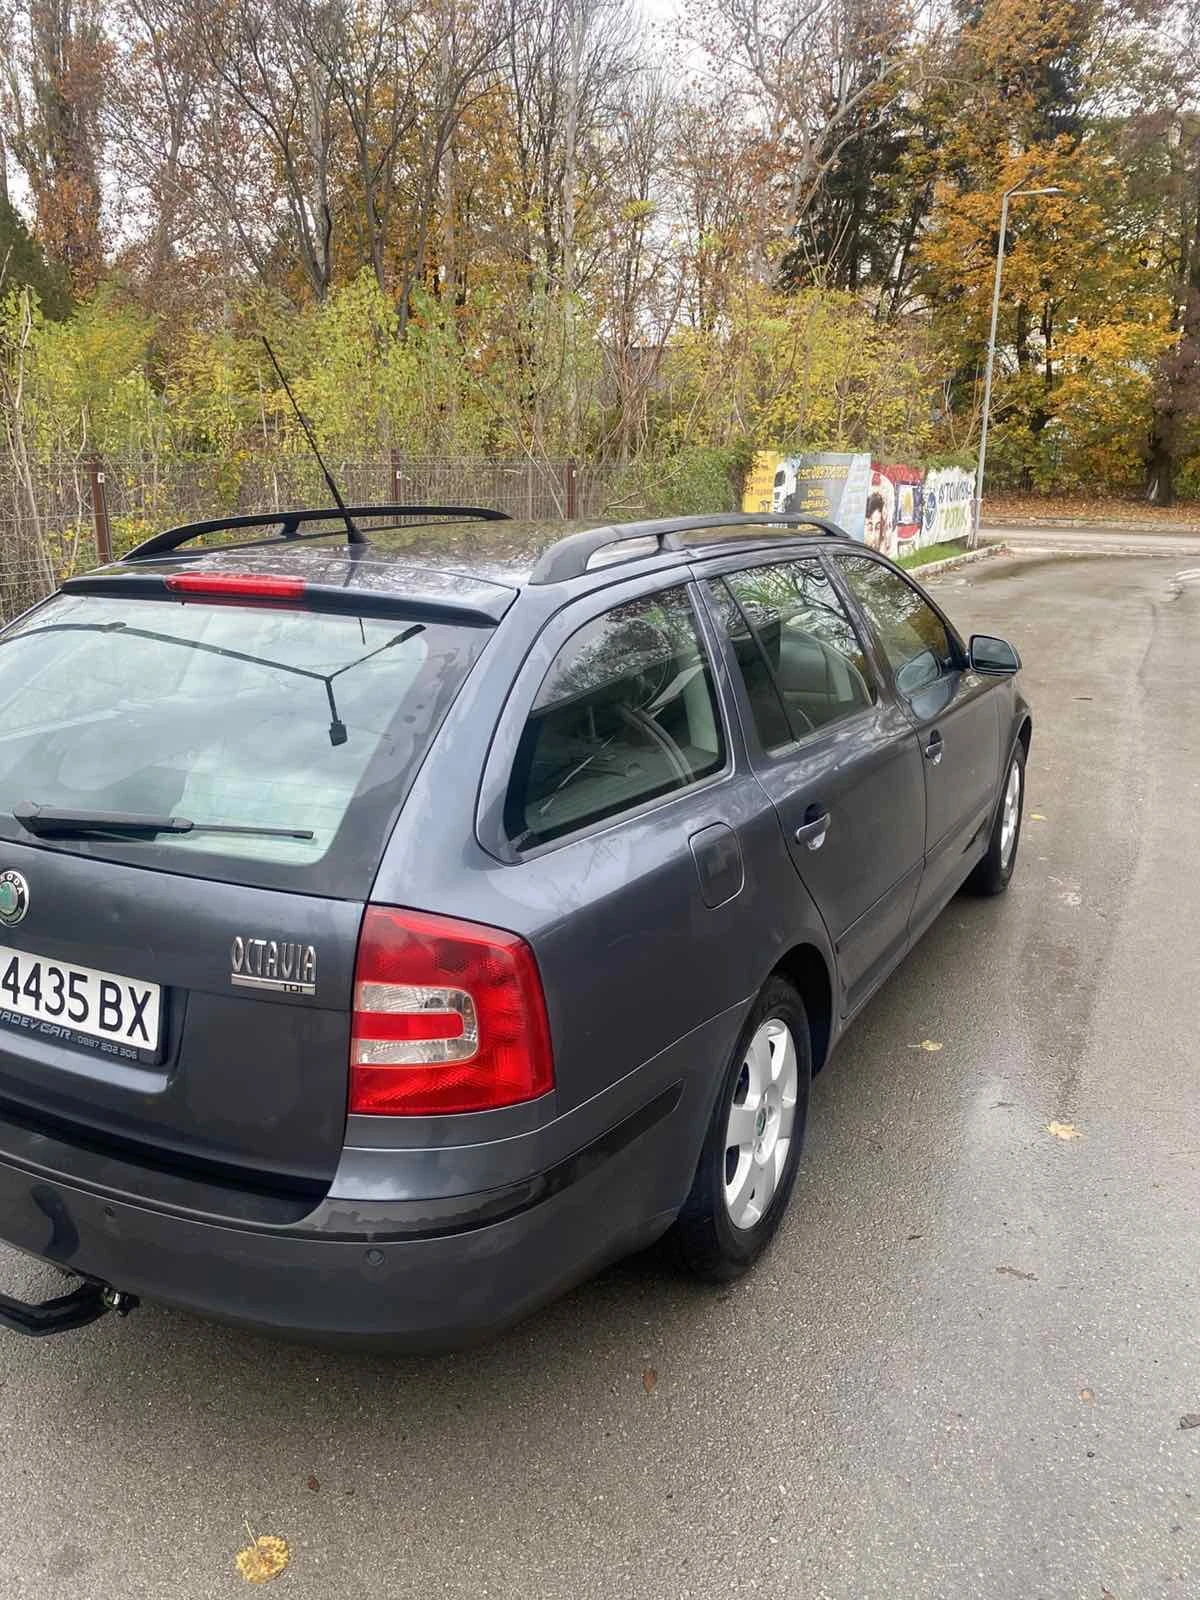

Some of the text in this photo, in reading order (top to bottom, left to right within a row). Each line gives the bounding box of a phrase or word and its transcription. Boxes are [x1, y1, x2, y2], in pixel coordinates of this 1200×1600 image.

[231, 936, 317, 982] OCTAVIA
[1, 956, 152, 1042] 4435 BX
[282, 983, 303, 993] TDI
[0, 1010, 72, 1041] ADEVCAR
